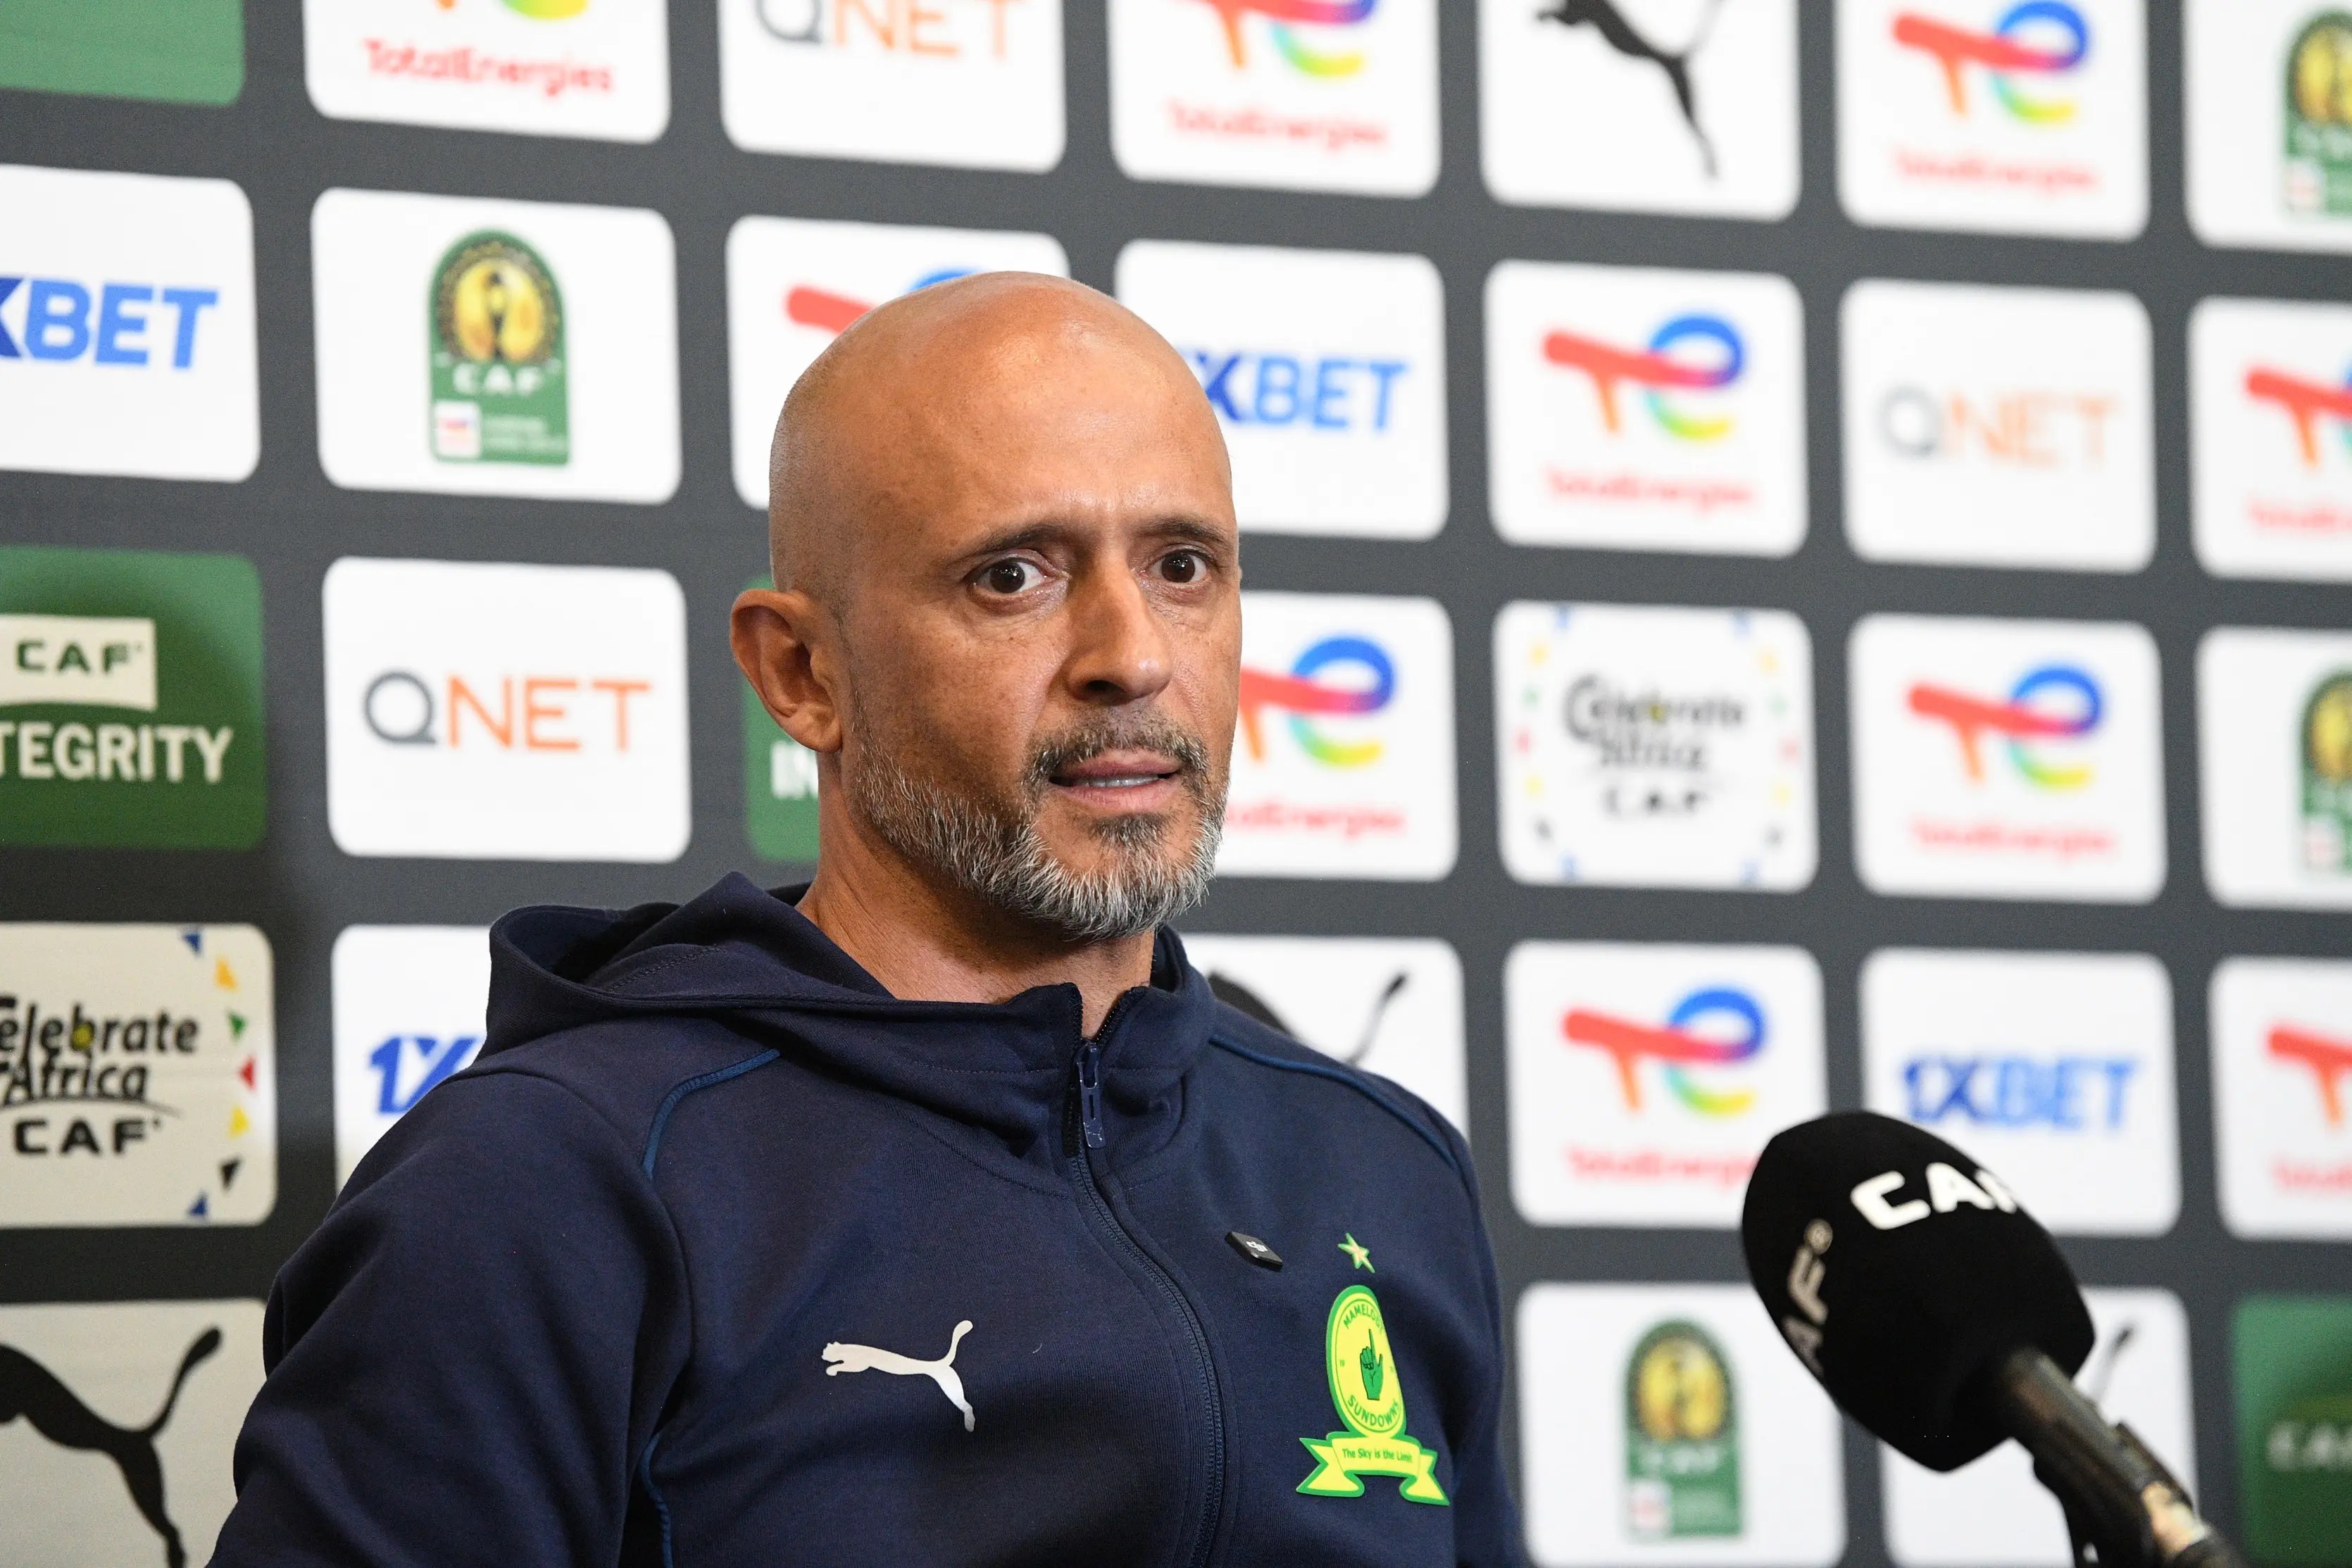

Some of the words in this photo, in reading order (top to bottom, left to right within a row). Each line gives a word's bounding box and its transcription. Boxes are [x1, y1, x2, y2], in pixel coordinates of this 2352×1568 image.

[756, 0, 1025, 61] QNET
[363, 37, 614, 97] TotalEnergies
[1190, 352, 1408, 434] XBET
[16, 640, 132, 674] CAF
[363, 670, 653, 752] QNET
[1903, 1056, 2138, 1132] 1XBET
[15, 1118, 146, 1155] CAF
[1342, 1448, 1356, 1459] The
[1358, 1448, 1372, 1461] Sky
[1374, 1448, 1381, 1460] is
[1383, 1448, 1396, 1460] the
